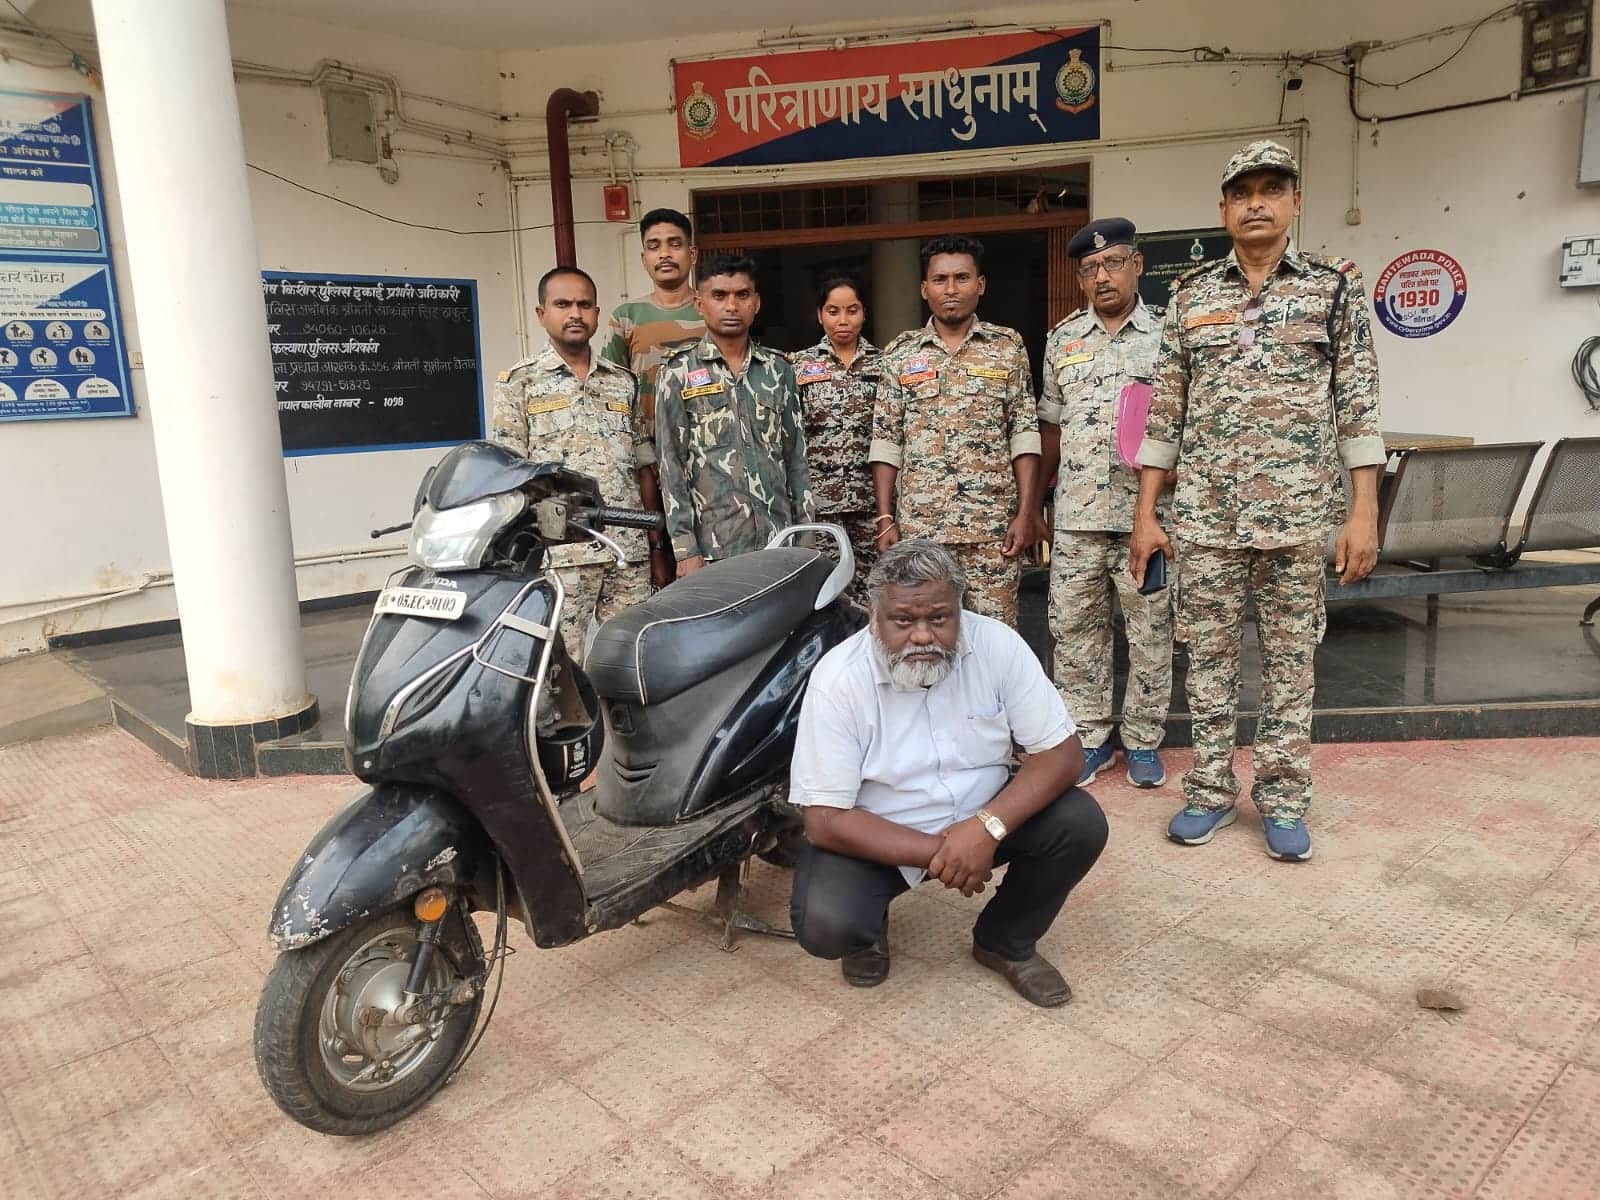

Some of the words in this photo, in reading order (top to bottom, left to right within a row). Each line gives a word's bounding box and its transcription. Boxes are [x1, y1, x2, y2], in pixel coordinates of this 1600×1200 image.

[725, 66, 889, 135] परित्राणाय
[1377, 253, 1434, 293] DANTEWADA
[1437, 255, 1464, 286] POLICE
[282, 280, 317, 296] किशोर
[319, 281, 350, 301] पुलिस
[386, 283, 414, 299] प्रभारी
[416, 285, 460, 302] अधिकारी
[1398, 289, 1440, 308] 1930
[307, 338, 339, 358] पुलिस
[384, 397, 404, 407] 1098
